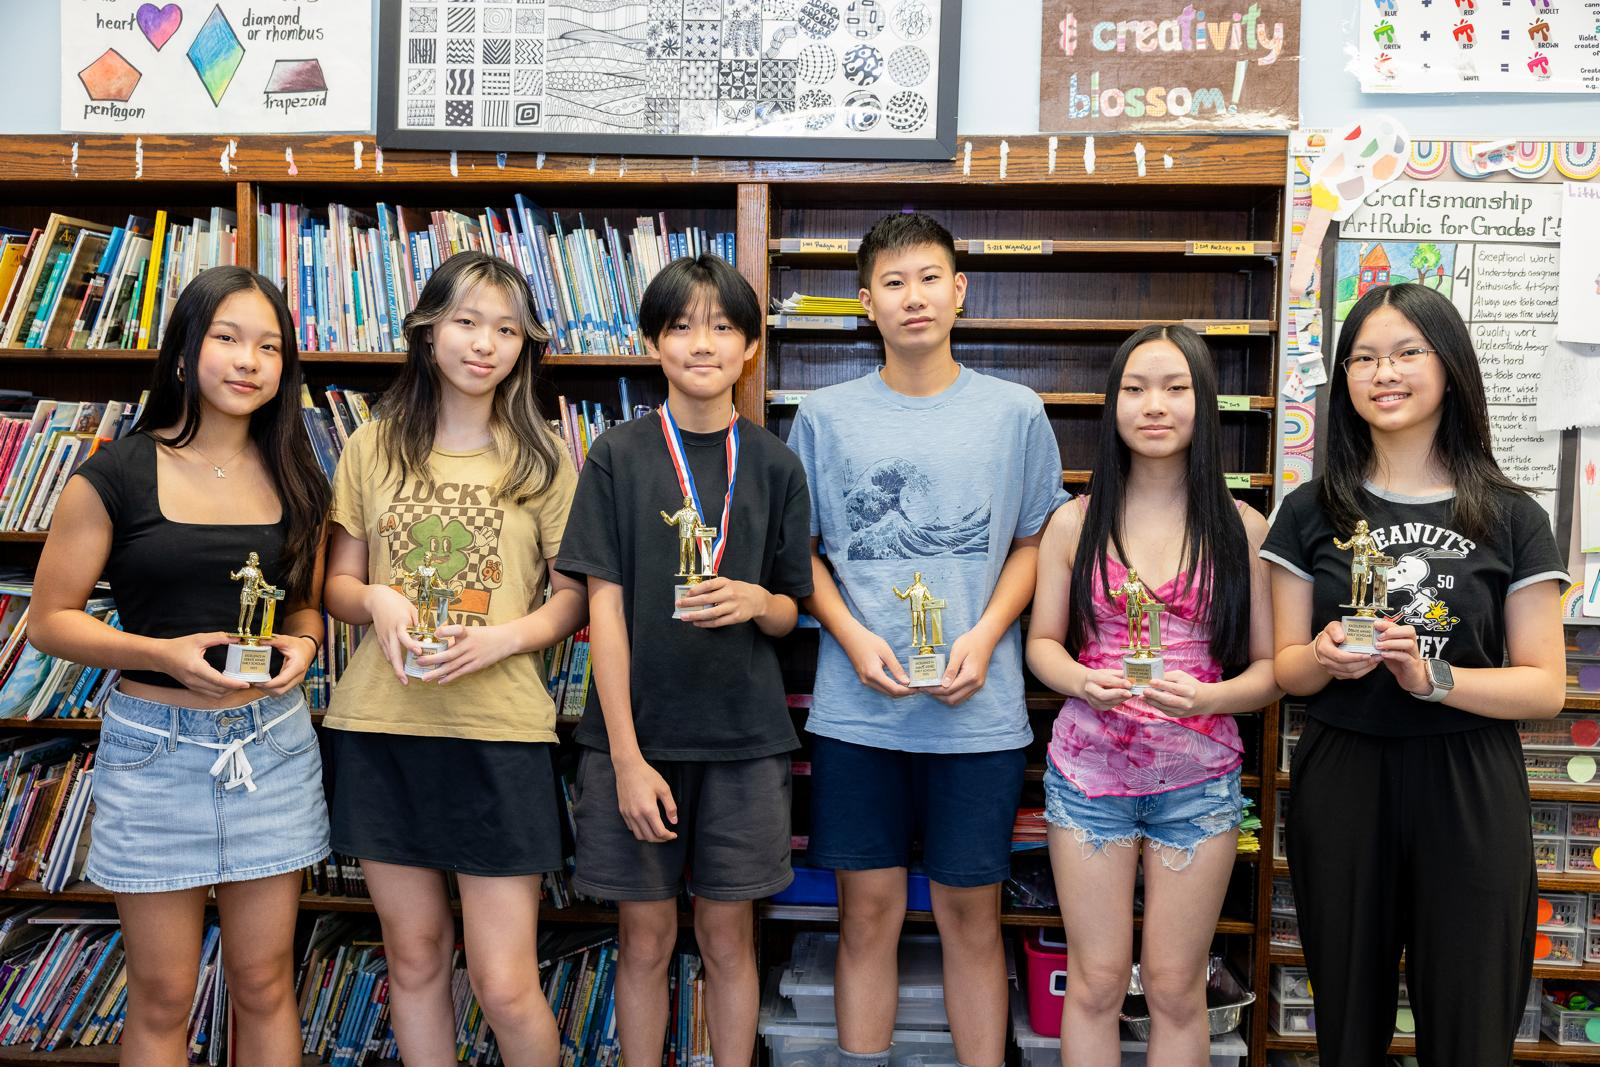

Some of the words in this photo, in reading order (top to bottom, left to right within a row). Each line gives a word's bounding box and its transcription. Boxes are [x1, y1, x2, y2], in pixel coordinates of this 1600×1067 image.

[96, 14, 137, 31] heart
[242, 7, 300, 27] diamond
[247, 29, 259, 40] or
[266, 25, 324, 41] rhombus
[1092, 3, 1284, 66] creativity
[1068, 60, 1248, 119] blossom!
[83, 102, 145, 122] pentagon
[263, 93, 327, 114] trapezoid
[1363, 188, 1533, 214] Craftsmanship
[1342, 214, 1377, 234] Art
[1380, 213, 1431, 234] Rubic
[1440, 215, 1468, 234] for
[1471, 216, 1536, 237] Grades
[1478, 250, 1525, 264] Exceptional
[1530, 253, 1555, 264] work
[1456, 265, 1470, 287] 4
[1477, 266, 1526, 277] Understands
[1474, 297, 1500, 308] Always
[1474, 308, 1502, 321] Always
[1520, 310, 1533, 319] time
[1476, 325, 1510, 342] Quality
[1515, 326, 1537, 337] work
[1476, 338, 1523, 350] Understands
[1503, 354, 1524, 365] hard
[1495, 368, 1513, 379] tools
[1492, 383, 1511, 393] time
[1502, 435, 1545, 443] understands
[391, 479, 499, 508] LUCKY
[378, 514, 397, 533] LA
[482, 567, 501, 584] 90
[1437, 574, 1455, 590] 50
